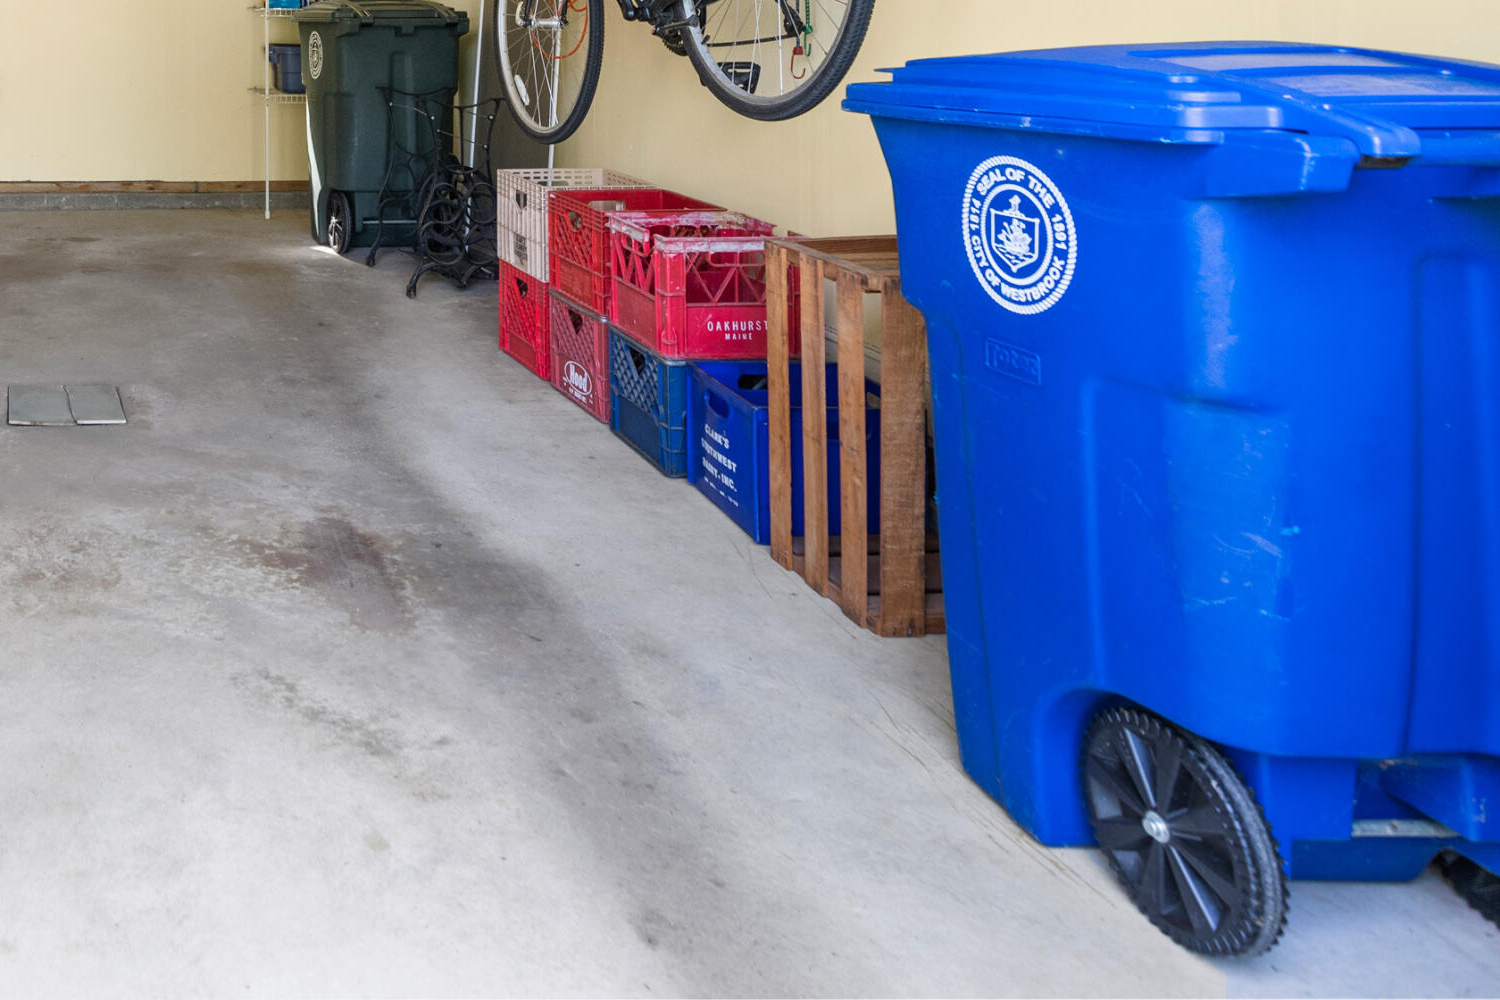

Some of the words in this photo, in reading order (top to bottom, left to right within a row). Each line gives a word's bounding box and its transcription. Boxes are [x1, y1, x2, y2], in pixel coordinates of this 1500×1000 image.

[976, 168, 1007, 196] SEAL
[1005, 167, 1025, 183] OF
[1028, 175, 1055, 209] THE
[1051, 213, 1068, 250] 1891
[971, 235, 989, 269] CITY
[984, 268, 1002, 288] OF
[1001, 256, 1065, 303] WESTBROOK
[707, 320, 769, 332] OAKHURST
[725, 332, 753, 341] MAINE
